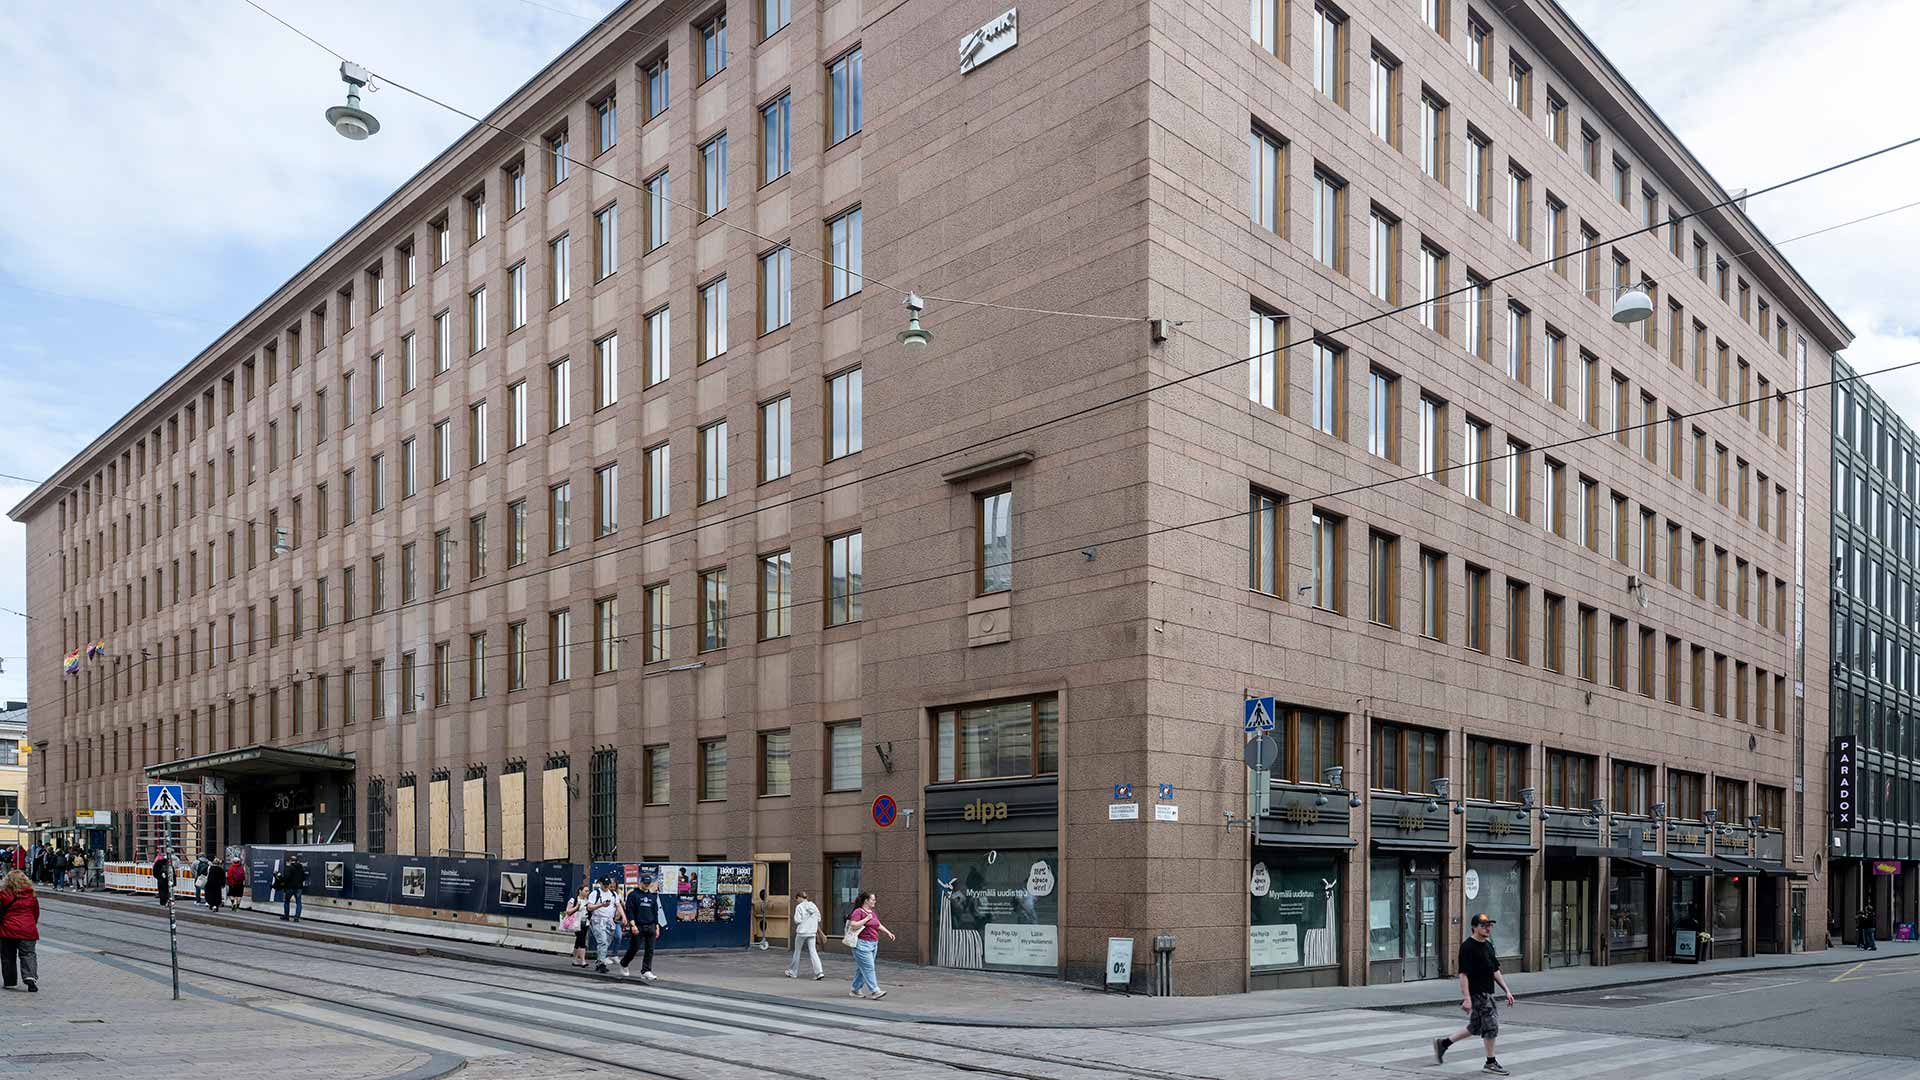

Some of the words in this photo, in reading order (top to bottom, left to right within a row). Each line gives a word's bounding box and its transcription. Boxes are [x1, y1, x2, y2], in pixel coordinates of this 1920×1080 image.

[1840, 742, 1849, 822] PARADOX
[964, 798, 1007, 824] alpa
[1287, 801, 1318, 826] alpa
[966, 888, 996, 898] Myymälä
[1113, 962, 1126, 974] 0%
